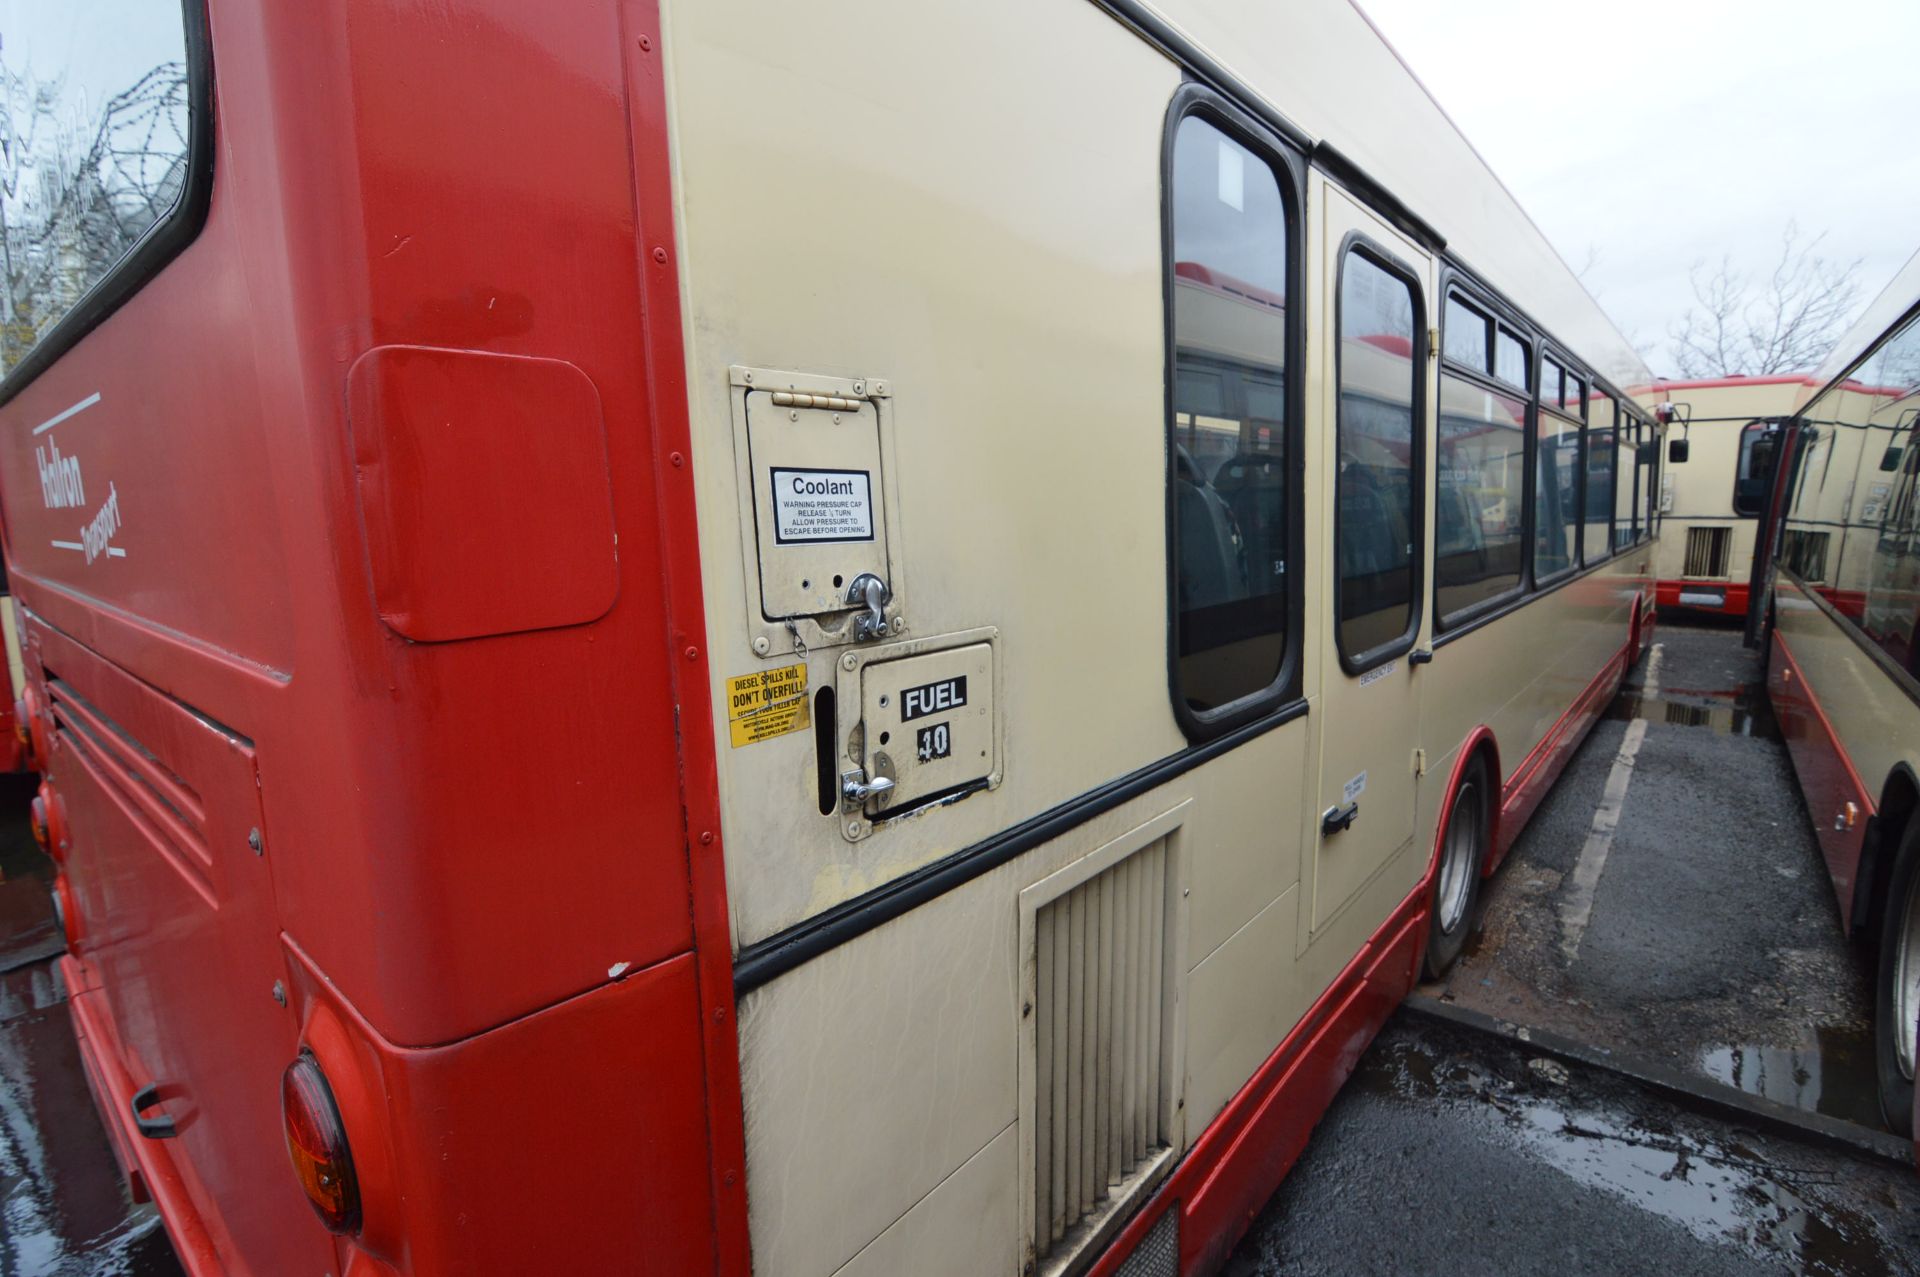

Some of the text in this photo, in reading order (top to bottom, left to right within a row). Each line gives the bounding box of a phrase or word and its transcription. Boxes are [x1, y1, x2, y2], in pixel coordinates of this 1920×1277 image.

[36, 433, 85, 508] Halton
[793, 477, 853, 494] Coolant
[80, 480, 121, 565] Transport
[733, 681, 802, 708] DON'T OVERFILL!
[735, 668, 799, 690] DIESEL SPILLS KILL
[906, 682, 963, 718] FUEL
